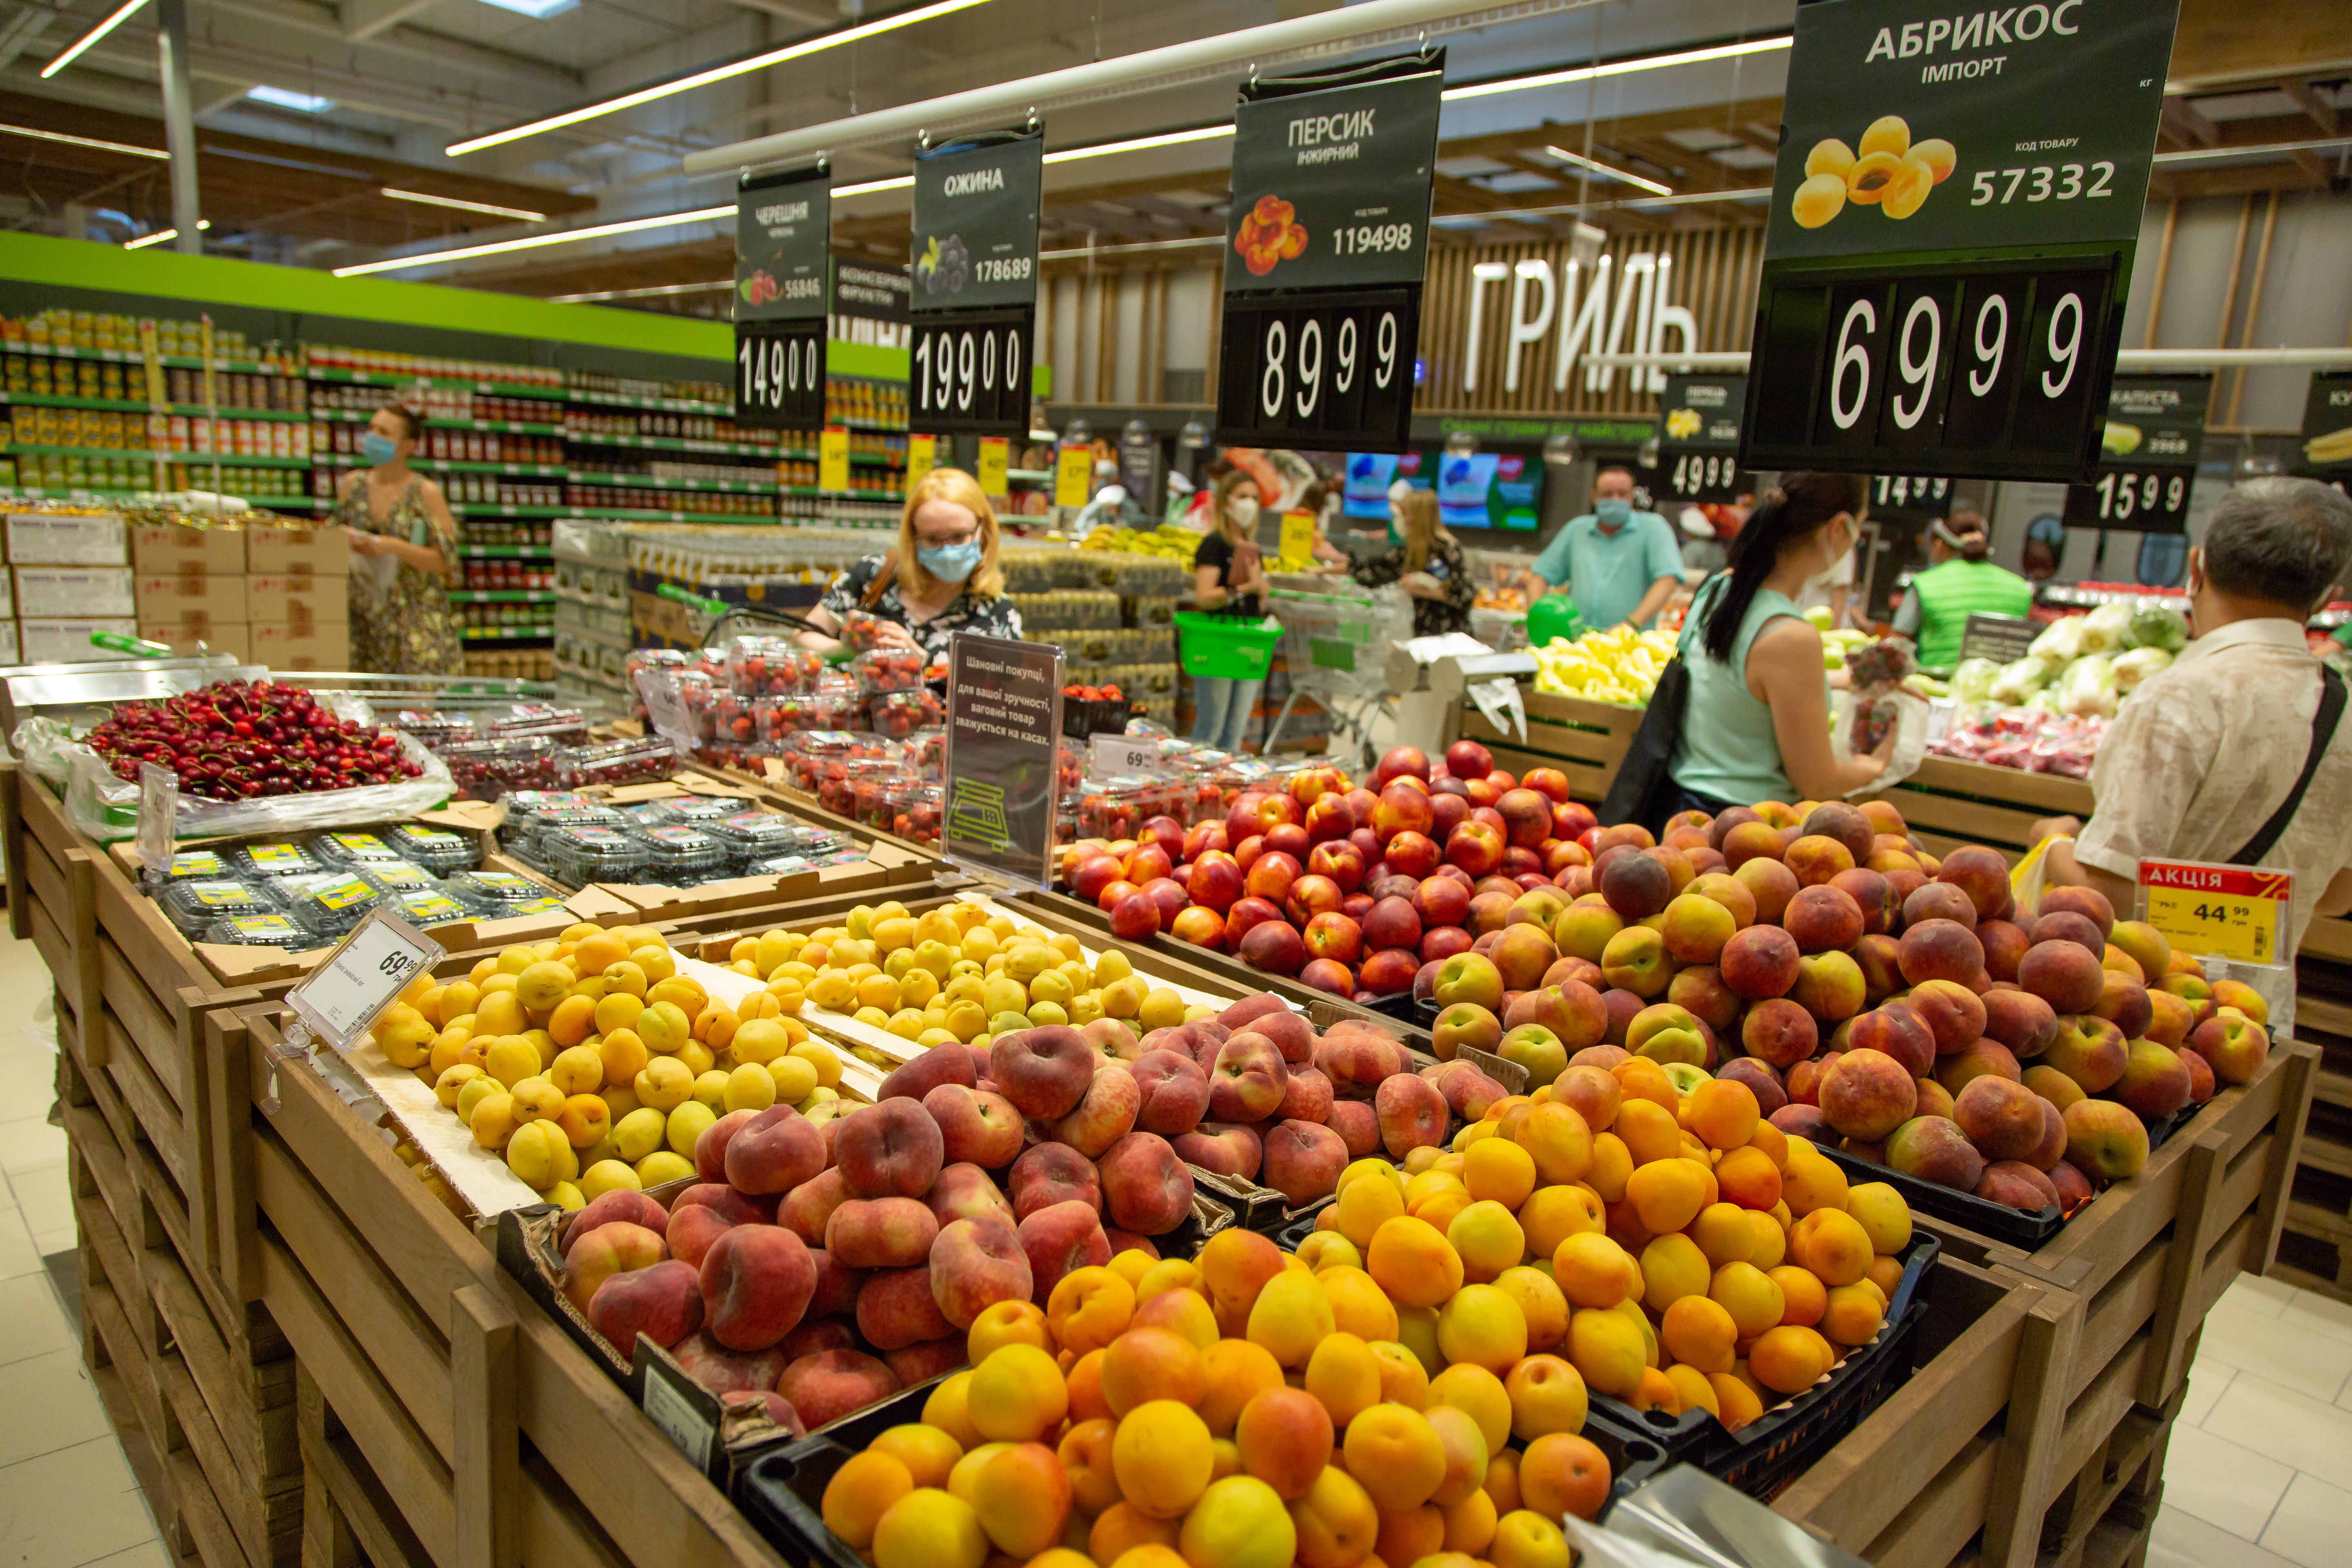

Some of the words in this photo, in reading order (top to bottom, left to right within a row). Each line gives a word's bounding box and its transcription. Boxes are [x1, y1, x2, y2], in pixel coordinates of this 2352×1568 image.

[1865, 0, 2083, 63] АБРИКОС
[1921, 56, 2007, 84] ІМПОРТ
[1288, 108, 1375, 148] ПЕРСИК
[1297, 141, 1359, 166] ІНЖИРНИЙ
[2015, 141, 2037, 152] КОД
[2039, 137, 2079, 149] ТОВАРУ
[944, 167, 1004, 197] ОЖИНА
[1970, 161, 2114, 206] 57332
[755, 200, 809, 225] ЧЕРЕШНЯ
[1333, 223, 1412, 255] 119498
[976, 256, 1031, 282] 178689
[1464, 252, 1697, 393] ГРИЛЬ
[967, 655, 1004, 673] Шановні
[1006, 666, 1045, 684] покупці,
[958, 683, 975, 695] для
[976, 688, 1003, 701] вашої
[1003, 693, 1051, 714] зручності,
[971, 702, 1007, 719] ваговий
[1008, 711, 1036, 727] товар
[956, 716, 1007, 735] зважується
[1008, 728, 1020, 739] на
[1021, 731, 1050, 746] касах.
[2149, 868, 2222, 888] АКЦІЯ
